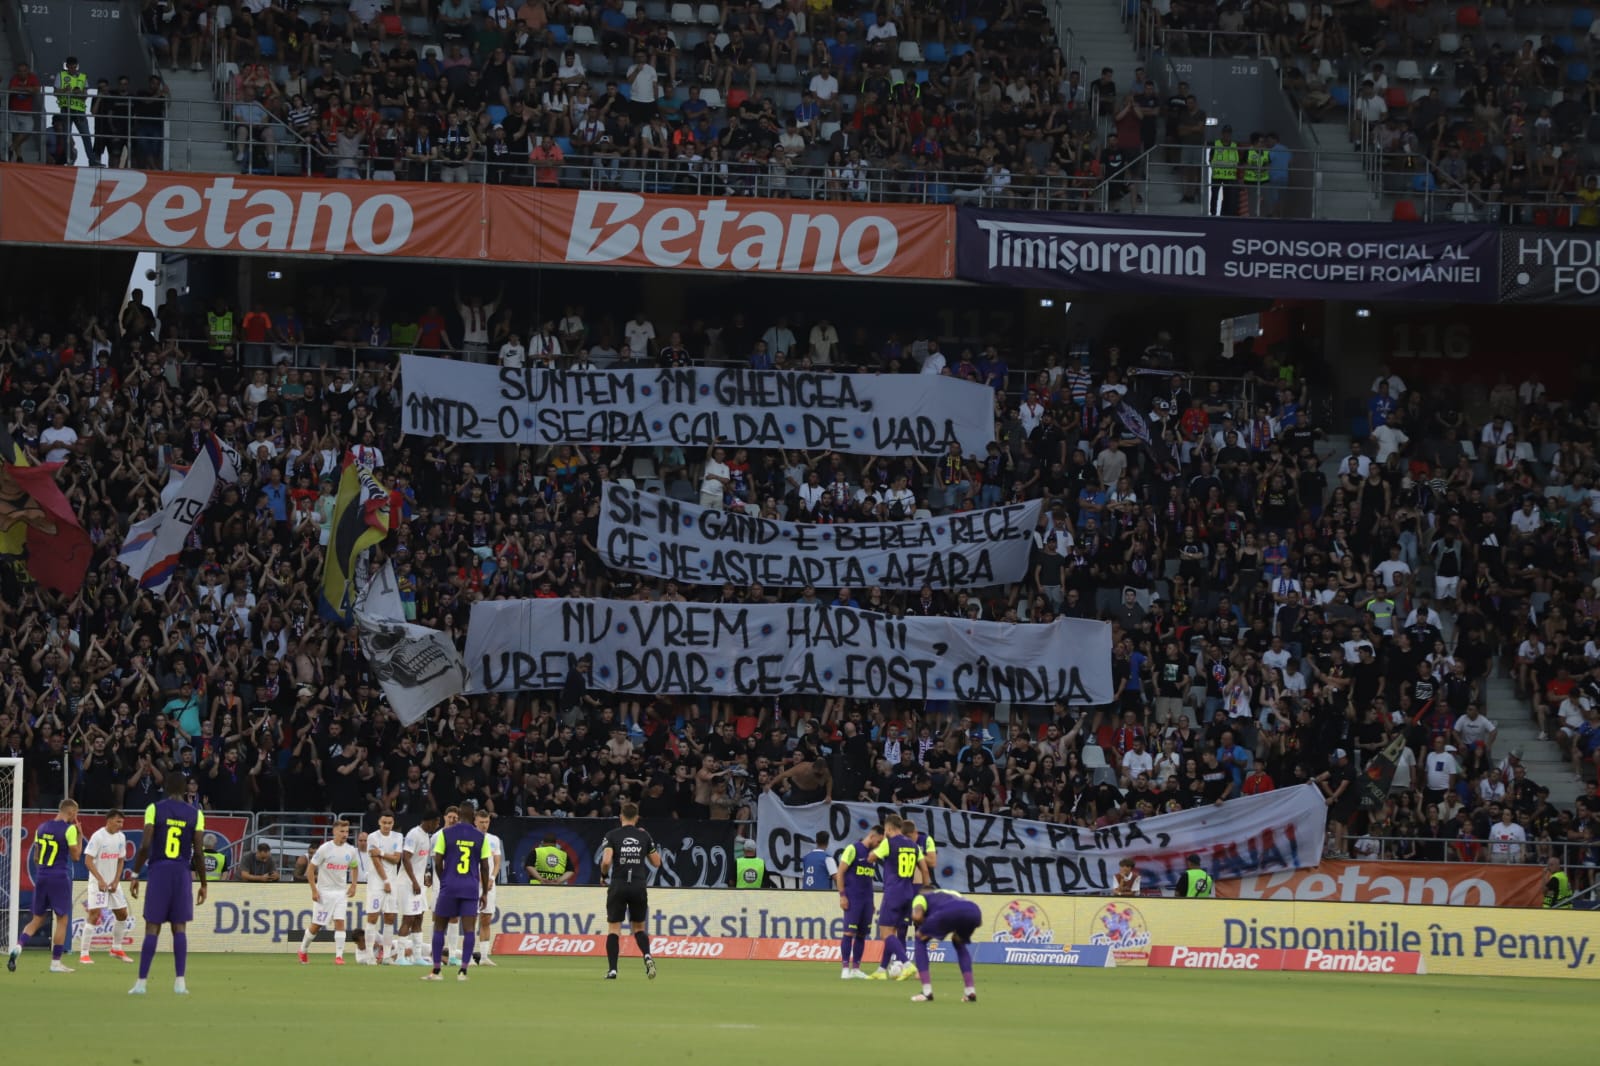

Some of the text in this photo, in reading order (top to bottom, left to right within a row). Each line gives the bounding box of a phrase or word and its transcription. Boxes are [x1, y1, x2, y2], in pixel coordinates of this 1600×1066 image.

[64, 168, 414, 254] Betano
[565, 190, 899, 275] Betano
[1231, 238, 1470, 260] SPONSOR OFICIAL AL
[1519, 237, 1600, 266] HYD
[1224, 261, 1481, 283] SUPERCUPEI ROMÂNIEI
[1392, 322, 1473, 359] 116
[500, 366, 635, 405] SUNTEM
[714, 367, 873, 413] GHENCEA,
[538, 408, 651, 443] SEARA
[669, 410, 785, 446] CALDA
[803, 413, 851, 449] DE
[790, 524, 819, 550] E
[833, 521, 936, 551] BEREA
[607, 527, 994, 588] CE NE ASTEAPTA AFARA
[562, 602, 613, 644] NU
[630, 603, 749, 649] VREM
[616, 648, 714, 693] DOAR
[838, 654, 936, 699] FOST
[165, 826, 182, 859] 6
[456, 846, 471, 875] 3
[965, 854, 1110, 893] PENTRU
[316, 911, 329, 922] 27
[372, 898, 380, 909] 8
[620, 904, 711, 937] ltex
[518, 935, 596, 954] Betano
[648, 938, 724, 957] Betano
[777, 941, 853, 960] Betan
[1170, 946, 1396, 973] Pambac Pambac
[1224, 917, 1595, 969] Disponibile în Penny,
